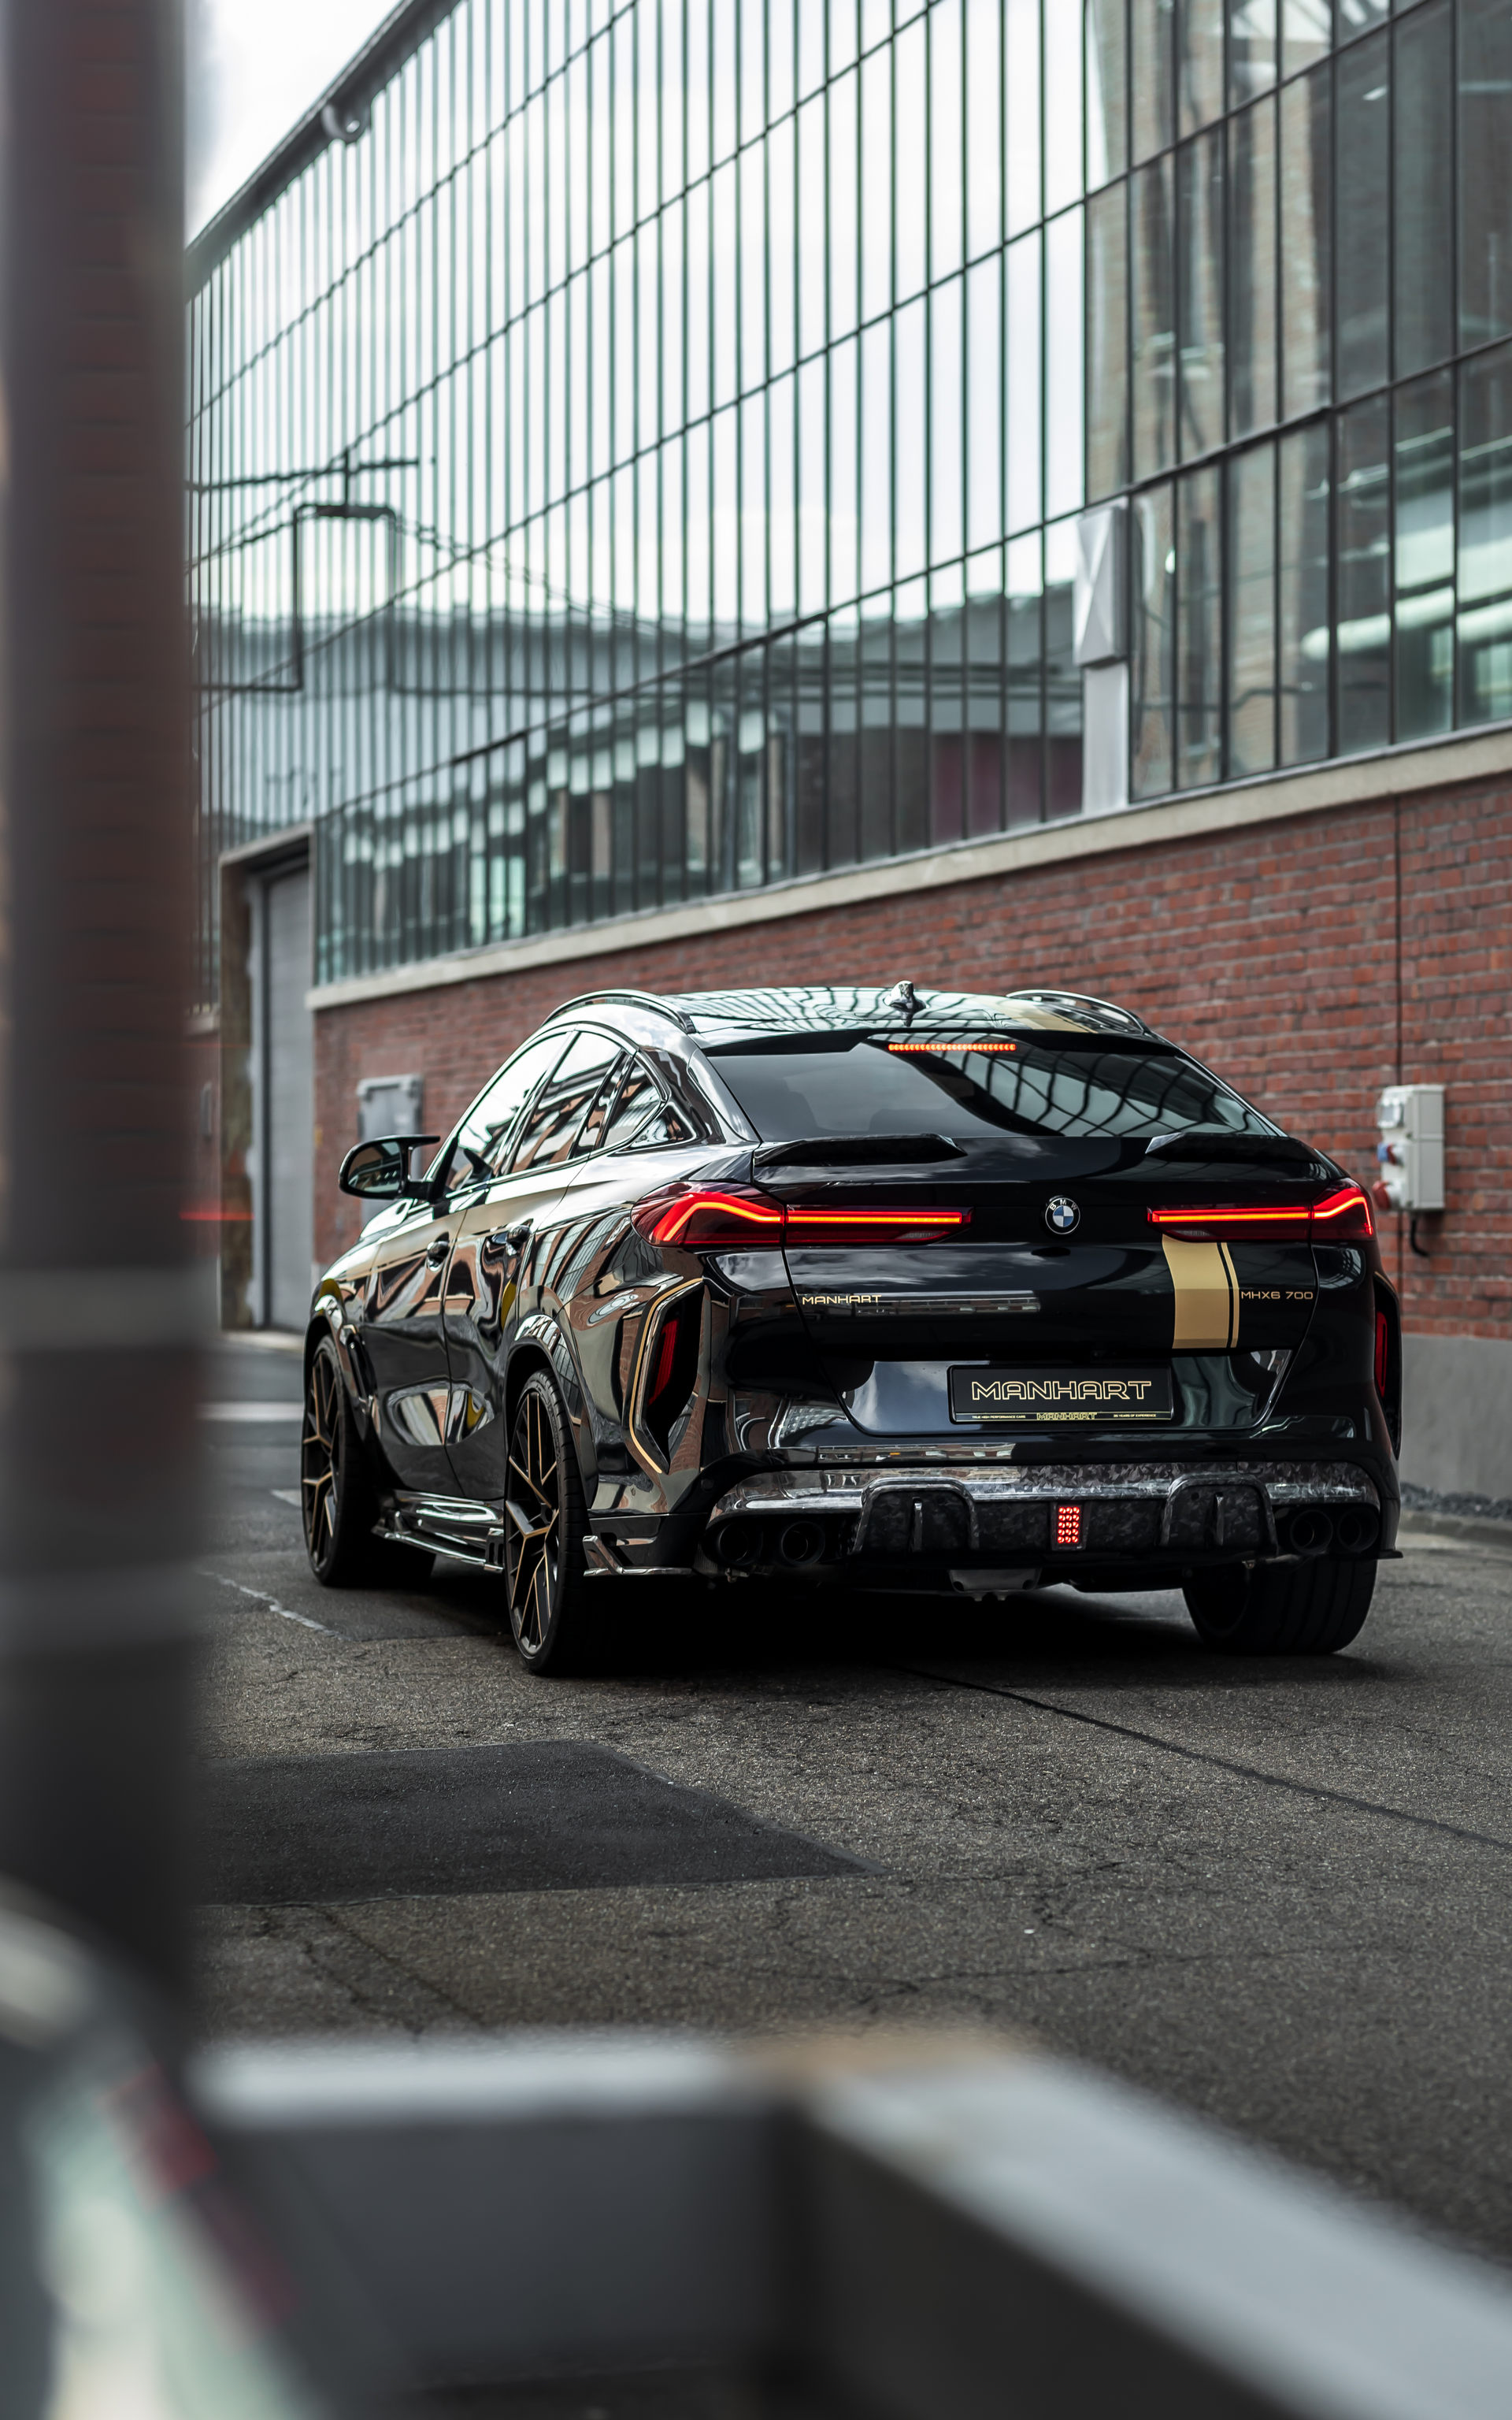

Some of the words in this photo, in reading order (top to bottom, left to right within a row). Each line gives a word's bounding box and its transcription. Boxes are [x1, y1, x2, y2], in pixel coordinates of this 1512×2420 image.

[1049, 1199, 1077, 1211] BMW
[802, 1294, 882, 1305] MANHART
[1241, 1291, 1280, 1300] MHX6
[1285, 1291, 1314, 1300] 700
[971, 1380, 1152, 1401] MANHART
[1036, 1412, 1098, 1420] MANHART
